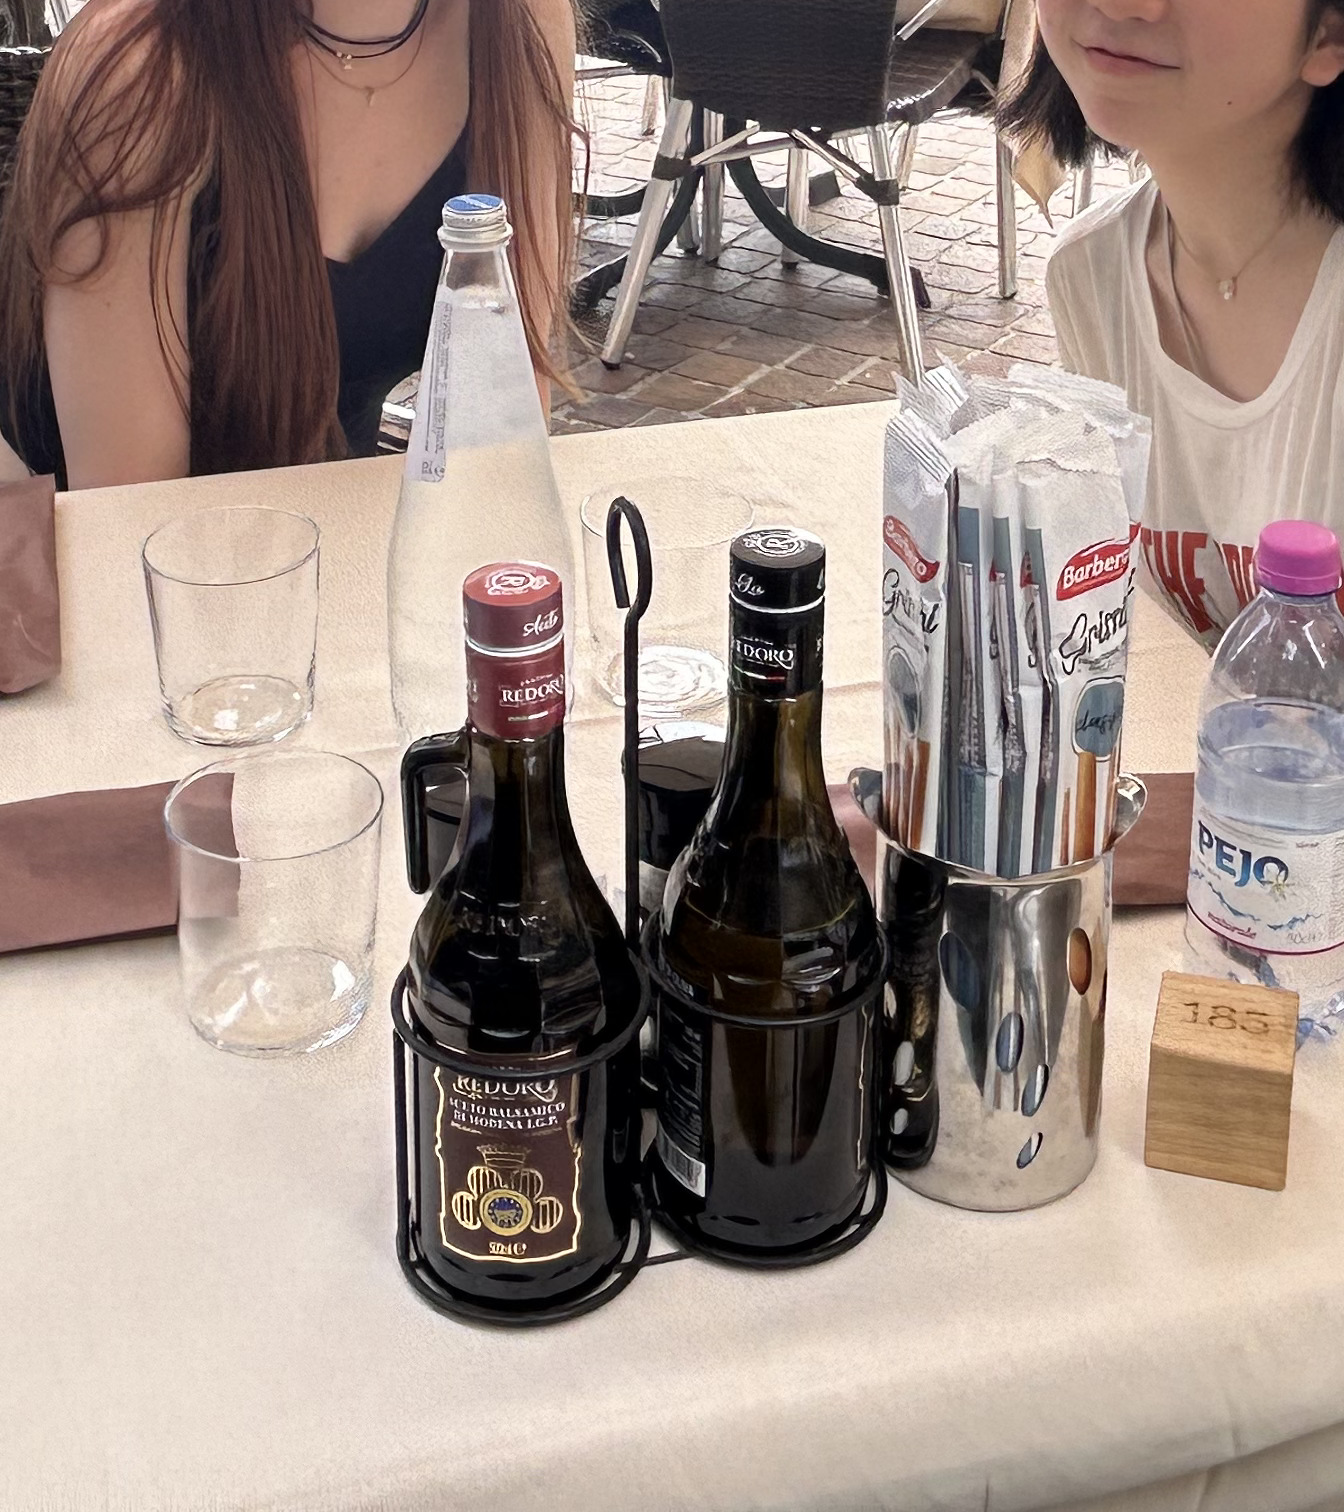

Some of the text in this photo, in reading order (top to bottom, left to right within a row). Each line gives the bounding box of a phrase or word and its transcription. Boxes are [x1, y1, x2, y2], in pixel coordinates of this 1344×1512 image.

[736, 639, 794, 670] EDORO
[1198, 820, 1289, 887] PEJO
[1182, 1002, 1270, 1034] 185
